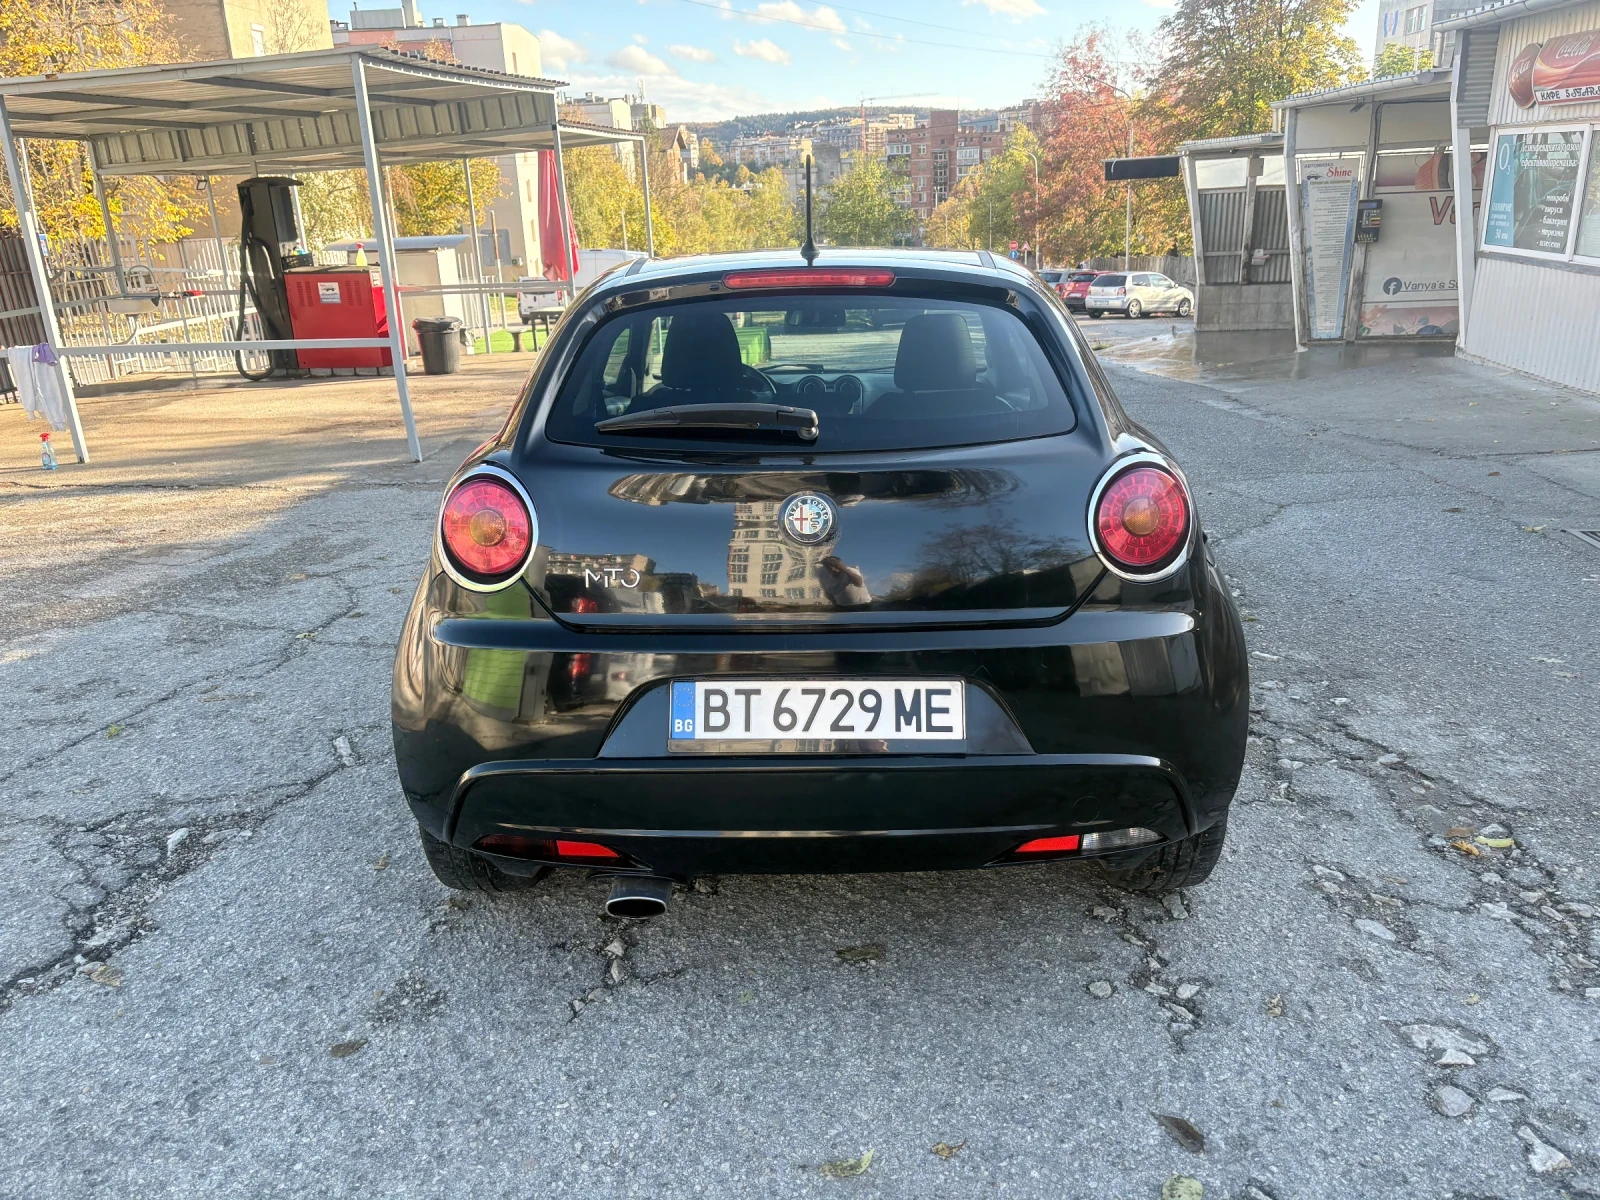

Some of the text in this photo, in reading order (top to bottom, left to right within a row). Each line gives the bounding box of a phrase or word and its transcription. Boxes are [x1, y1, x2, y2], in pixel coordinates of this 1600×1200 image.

[1540, 90, 1561, 101] КАФЕ
[1326, 166, 1352, 178] Shine
[1403, 281, 1446, 292] Vanya's
[703, 688, 954, 733] BT 6729 ME
[674, 719, 694, 732] BG
